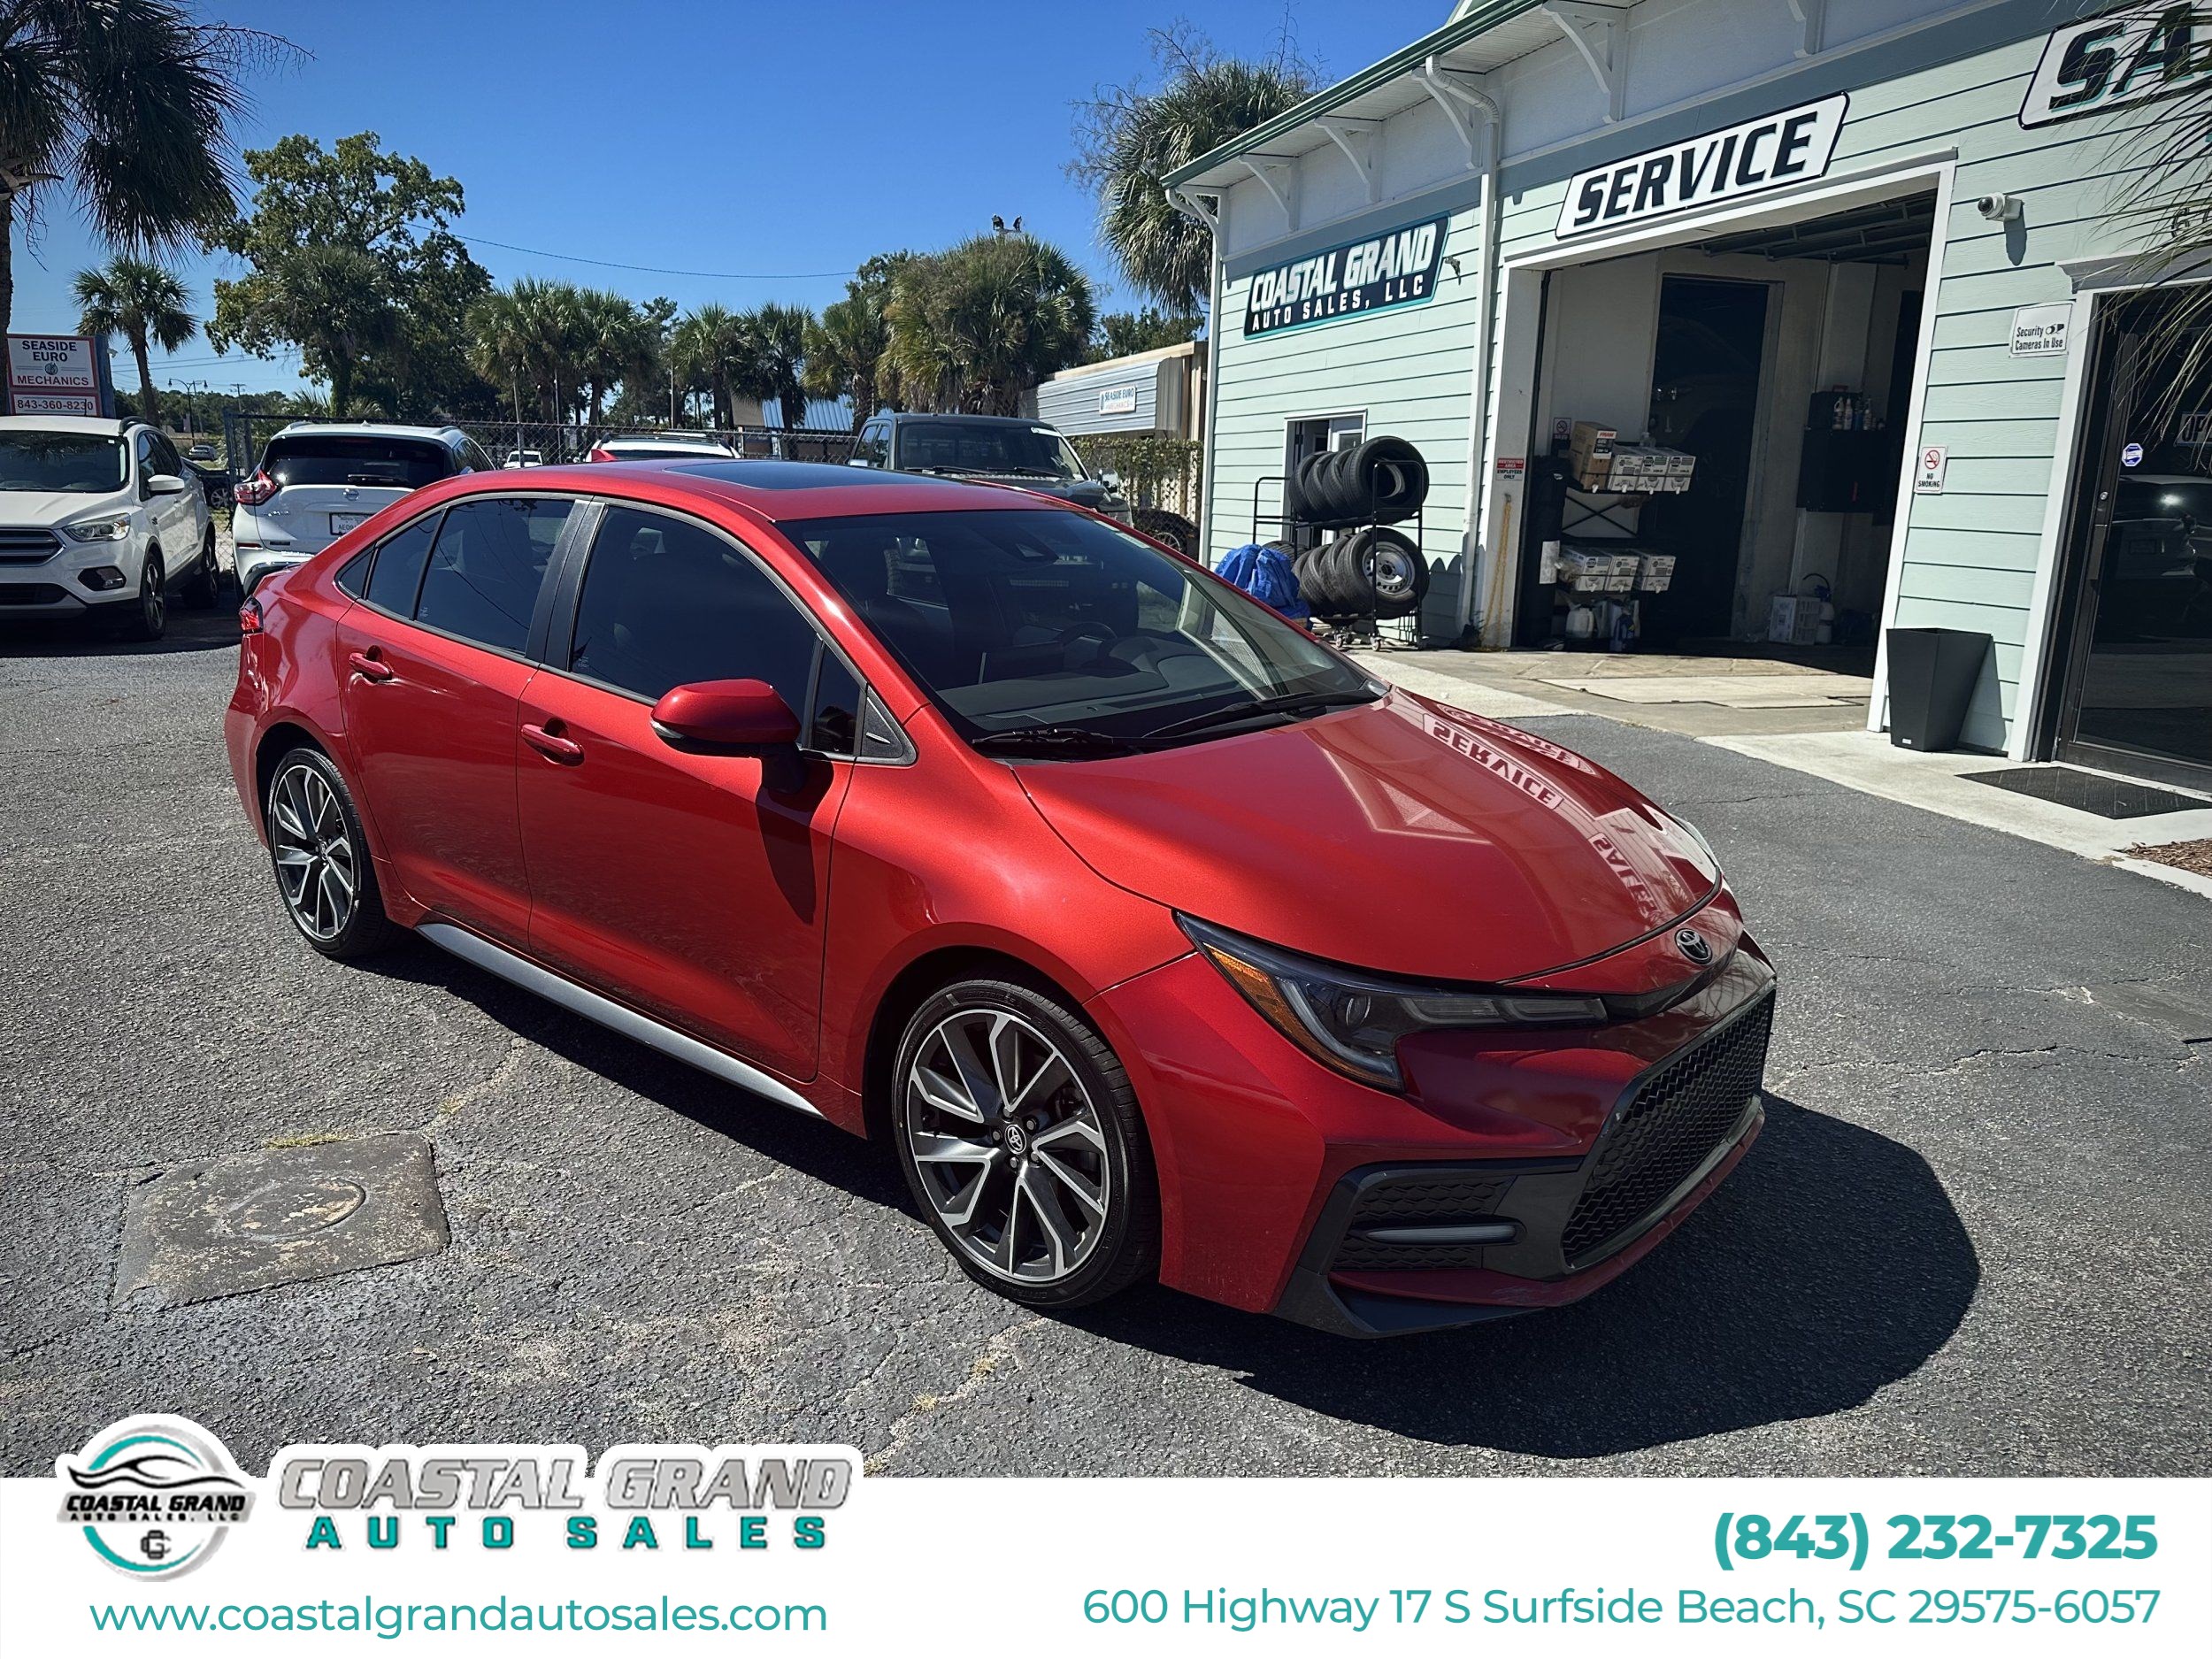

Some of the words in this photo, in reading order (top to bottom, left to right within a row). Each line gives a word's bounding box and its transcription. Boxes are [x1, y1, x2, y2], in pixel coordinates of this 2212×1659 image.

[2048, 1, 2212, 112] SA
[1573, 111, 1818, 227] SERVICE
[1251, 252, 1339, 312] COASTAL
[1343, 223, 1437, 289] GRAND
[1252, 306, 1292, 331] AUTO
[1302, 289, 1370, 319] SALES,
[1385, 274, 1424, 302] LLC
[2016, 326, 2044, 338] Security
[22, 341, 77, 351] SEASIDE
[2015, 340, 2042, 350] Cameras
[2043, 338, 2050, 349] In
[2051, 337, 2063, 349] Use
[33, 351, 68, 362] EURO
[17, 375, 88, 386] MECHANICS
[17, 399, 94, 411] 843-360-8230
